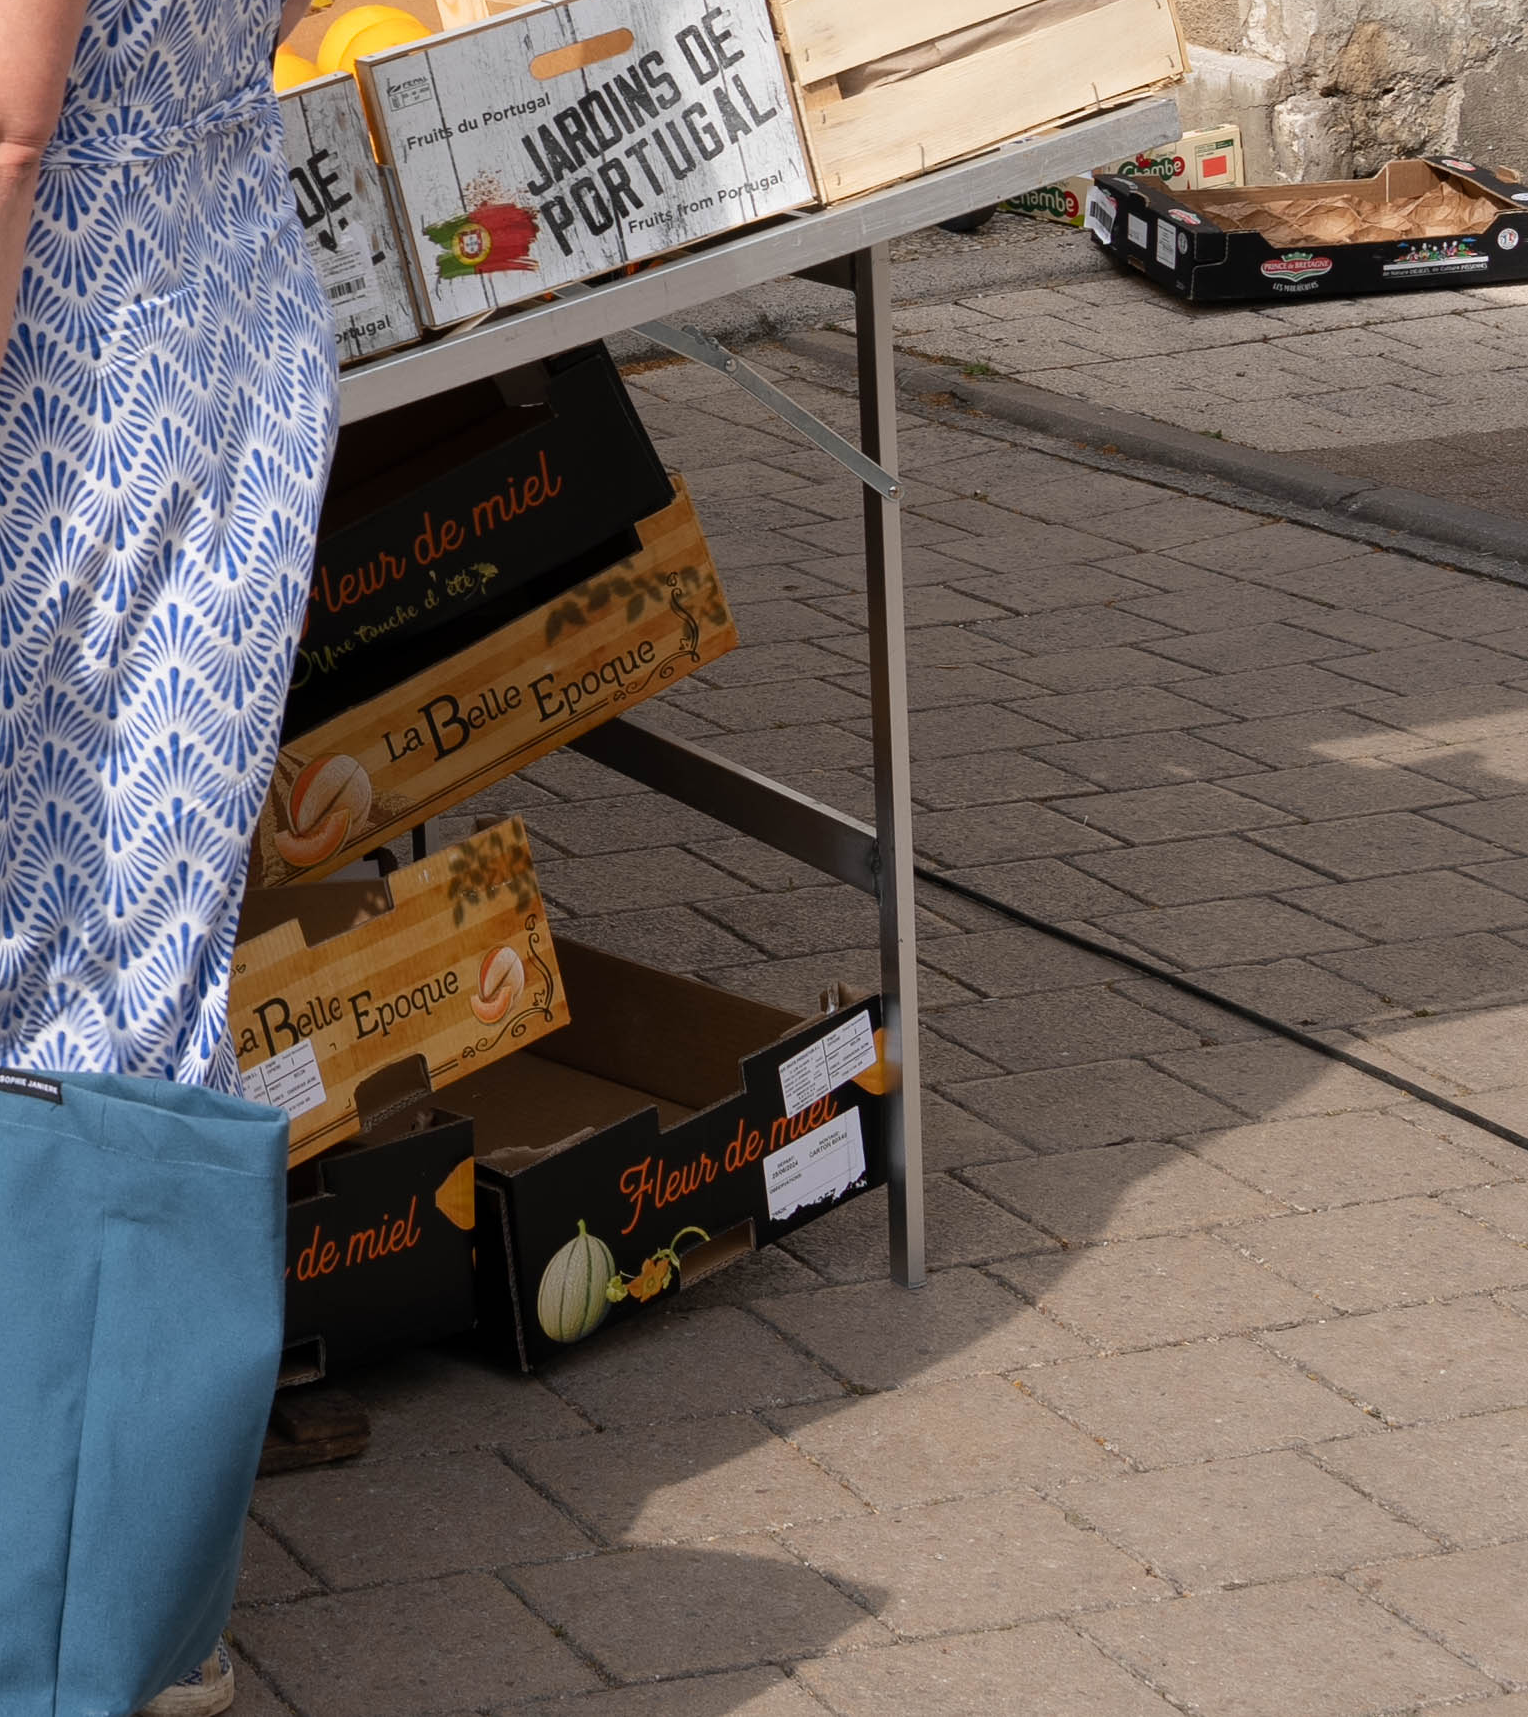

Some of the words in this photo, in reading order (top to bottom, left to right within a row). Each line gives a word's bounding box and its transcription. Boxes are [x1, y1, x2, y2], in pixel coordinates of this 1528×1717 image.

[407, 126, 454, 150] Fruits
[458, 118, 479, 134] du
[482, 92, 551, 126] Portugal
[520, 50, 684, 194] JARDINS
[677, 6, 746, 79] DE
[540, 74, 779, 257] PORTUGAL
[627, 209, 669, 236] Fruits
[674, 194, 714, 222] from
[717, 168, 785, 210] Portugal
[1263, 261, 1288, 272] PRINCE
[1294, 258, 1330, 271] BRETAGNE
[336, 314, 392, 345] ortugal
[412, 512, 466, 565] de
[472, 450, 563, 538] miel
[354, 603, 420, 643] touche
[380, 718, 428, 764] La
[417, 681, 523, 764] Belle
[526, 636, 658, 724] Epoque
[253, 996, 343, 1057] Belle
[348, 970, 461, 1041] Epoque
[620, 1153, 719, 1236] Fleur
[724, 1115, 764, 1171] de
[768, 1093, 838, 1157] miel
[296, 1226, 341, 1280] de
[346, 1195, 422, 1268] miel
